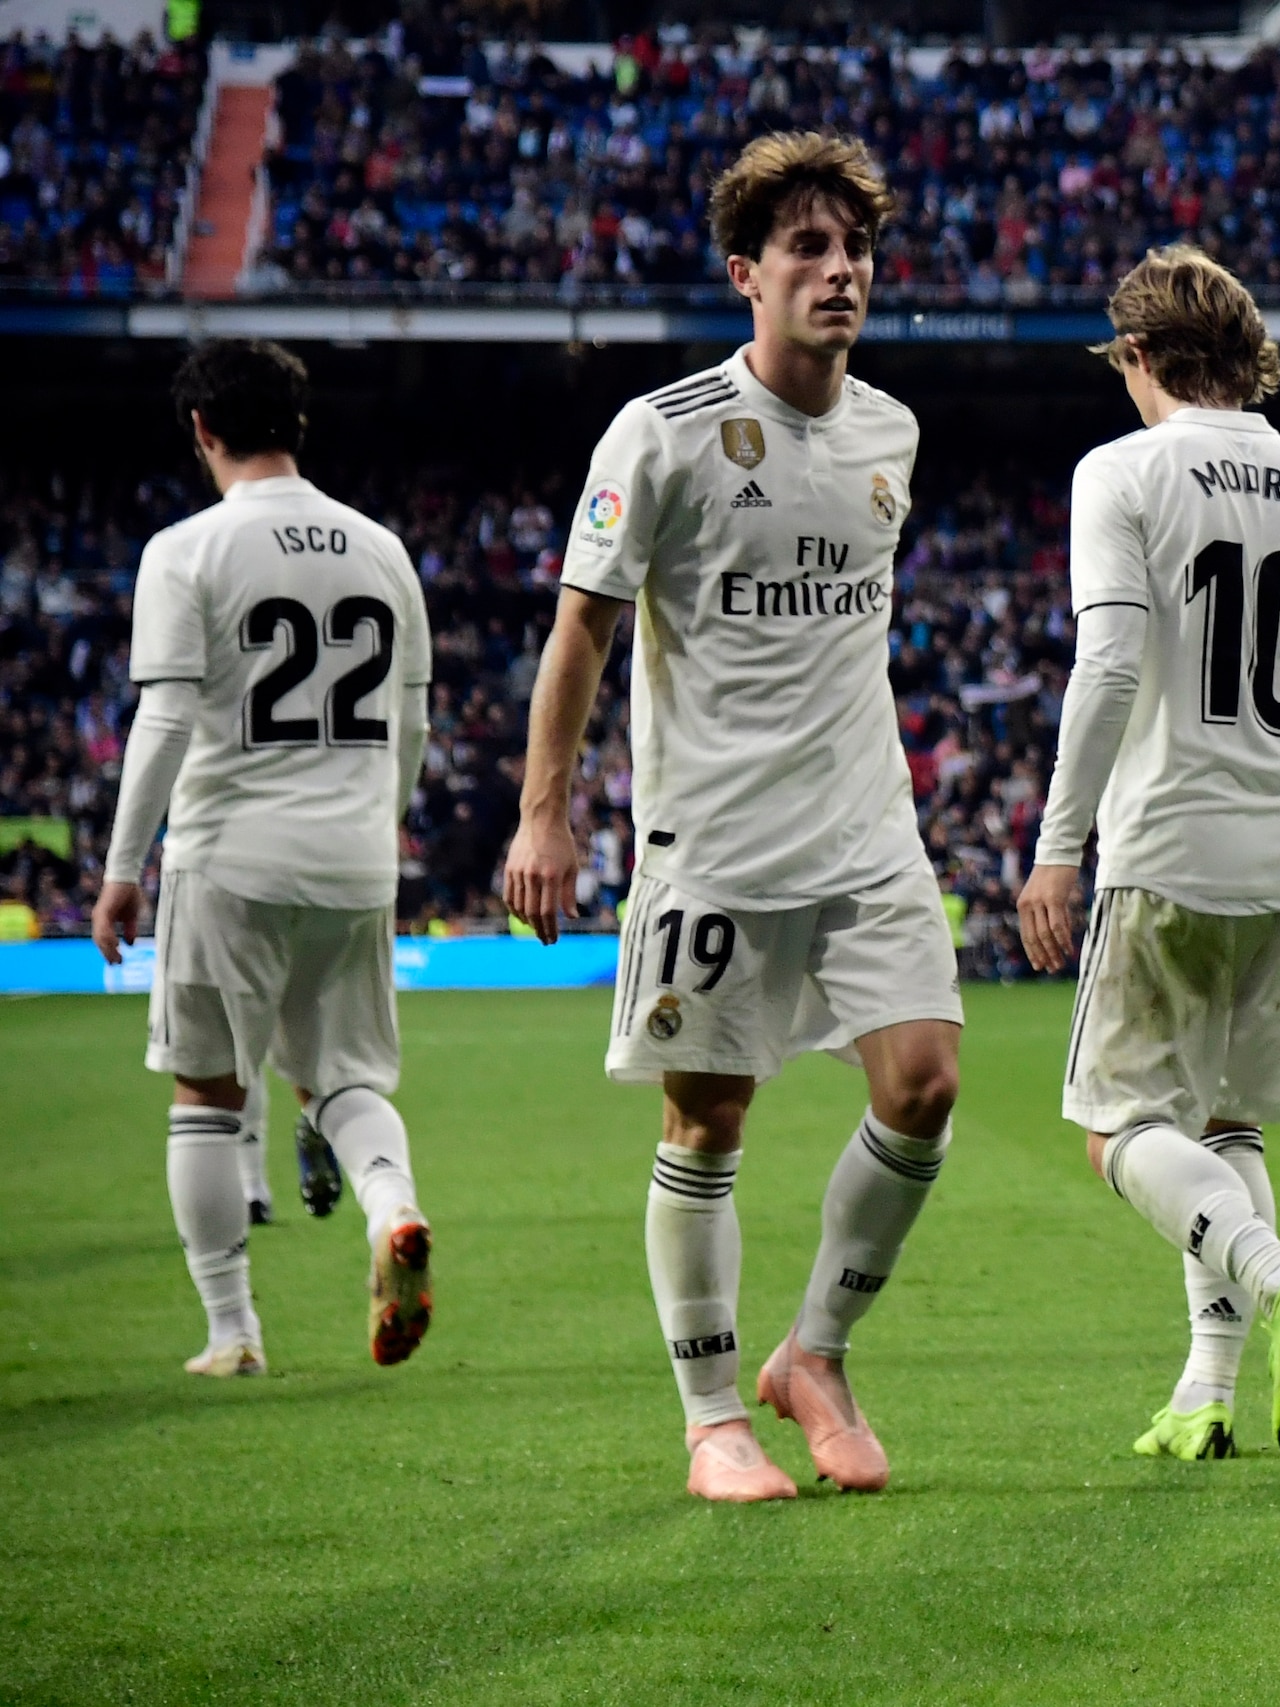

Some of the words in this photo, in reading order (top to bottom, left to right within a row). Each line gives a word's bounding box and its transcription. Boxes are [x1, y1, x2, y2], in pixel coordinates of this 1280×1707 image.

[273, 526, 347, 554] ISCO
[796, 536, 849, 574] Fly
[239, 596, 396, 750] 22
[652, 909, 737, 994] 19
